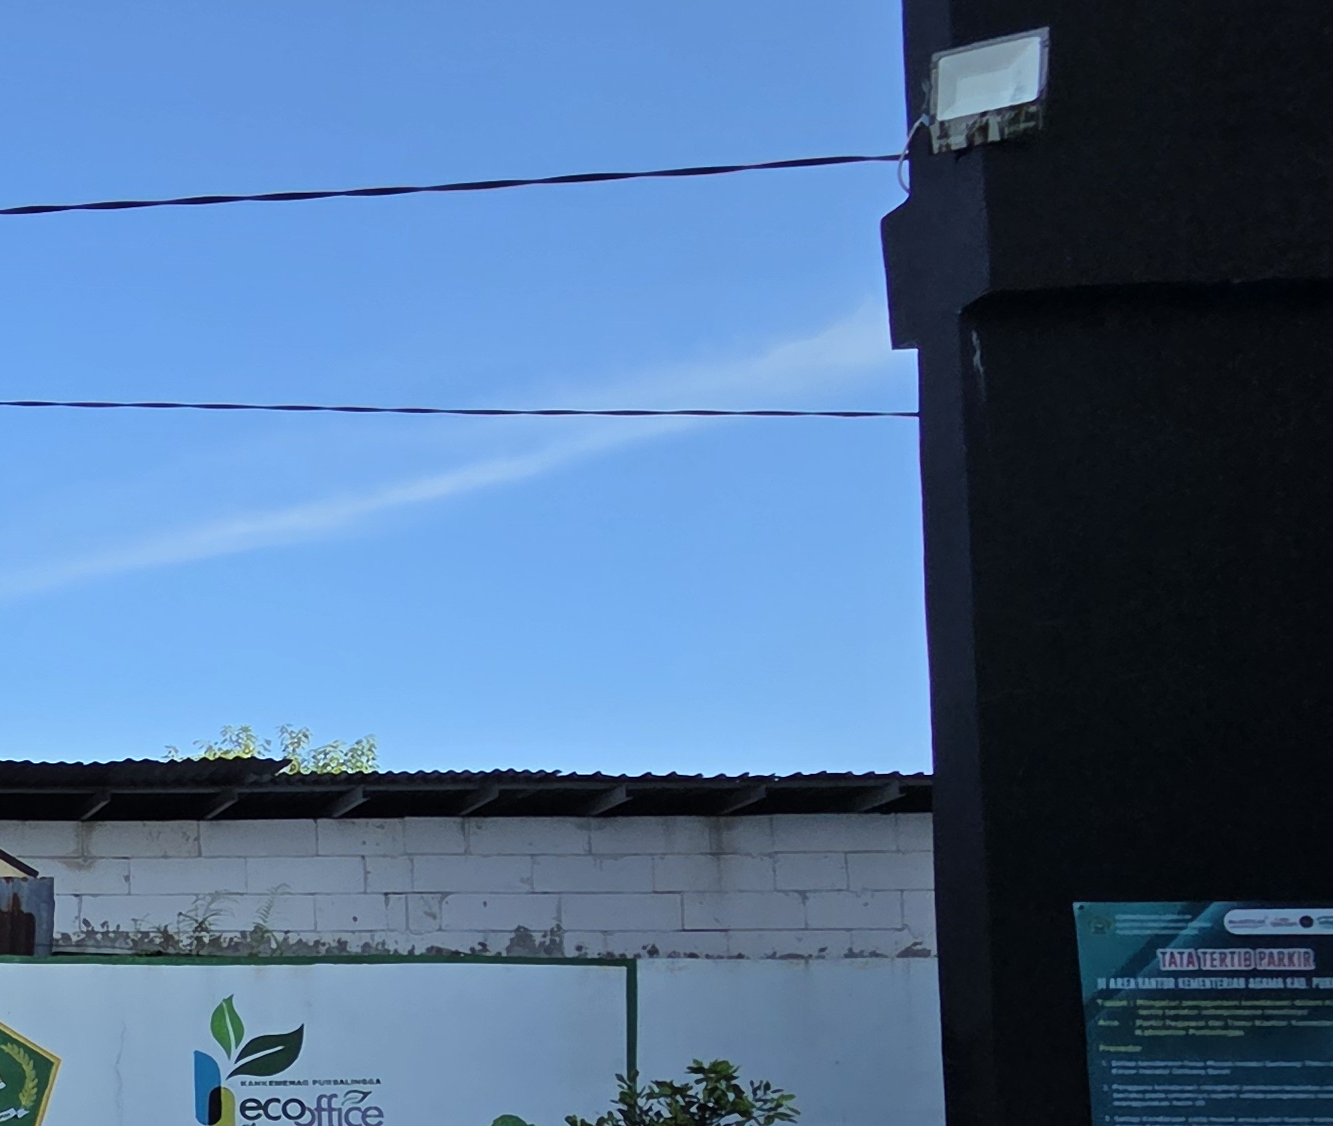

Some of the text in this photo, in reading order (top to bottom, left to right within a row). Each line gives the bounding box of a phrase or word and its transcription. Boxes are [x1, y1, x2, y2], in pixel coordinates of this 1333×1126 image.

[1159, 950, 1315, 969] TATA TERTIB PARKIR
[312, 1078, 382, 1086] PURBALINGGA
